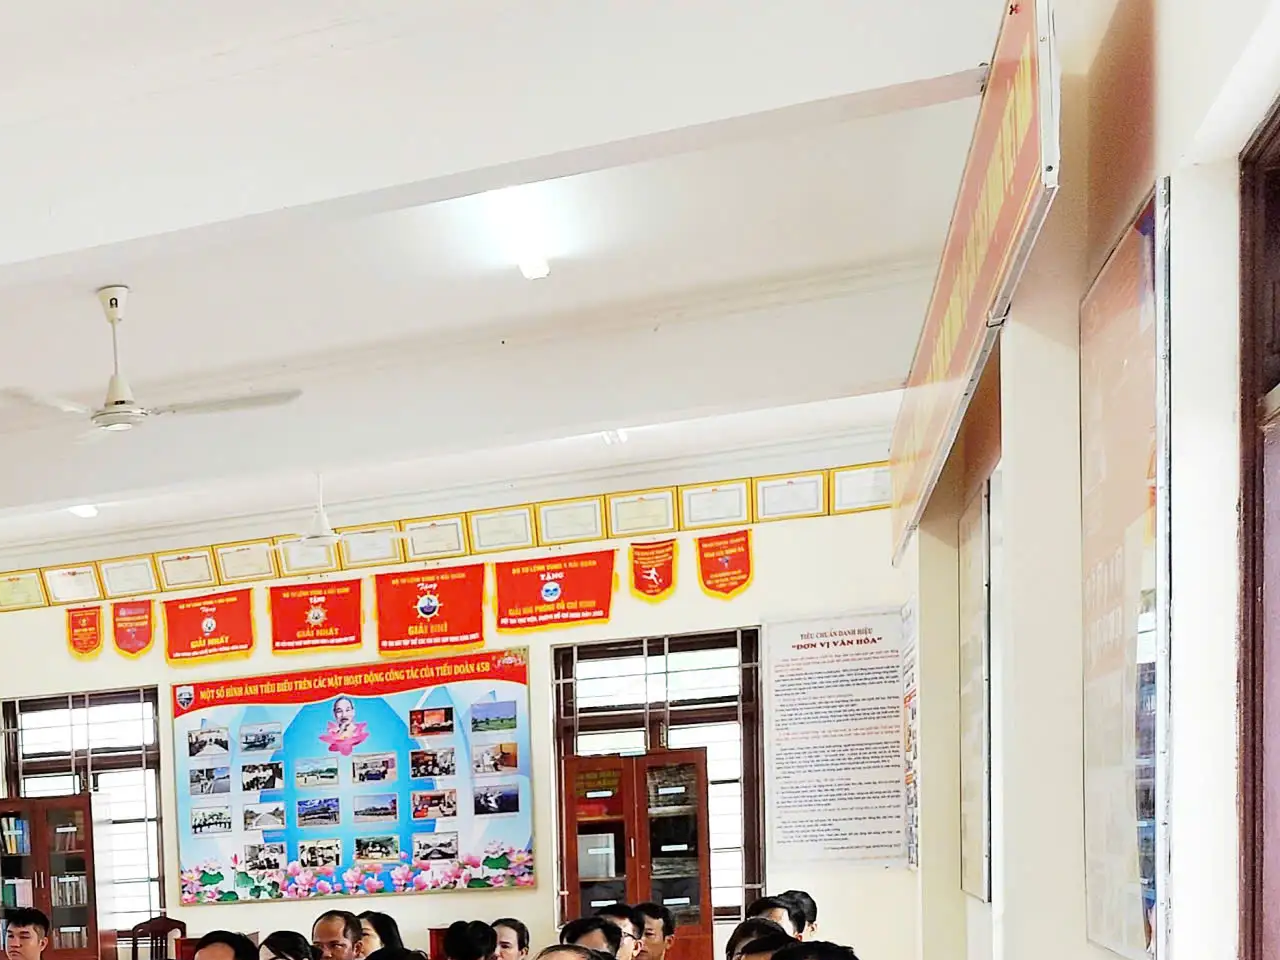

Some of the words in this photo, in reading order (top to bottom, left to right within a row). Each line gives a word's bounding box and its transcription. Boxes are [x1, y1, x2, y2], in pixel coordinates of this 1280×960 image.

[199, 688, 215, 701] MỘT
[216, 686, 225, 699] SỐ
[294, 677, 312, 690] TRÊN
[313, 675, 326, 689] CÁC
[327, 674, 342, 688] MẶT
[343, 674, 363, 687] HOẠT
[363, 671, 384, 685] ĐỘNG
[385, 668, 405, 682] CÔNG
[405, 666, 420, 679] TÁC
[420, 664, 434, 678] CỦA
[435, 662, 453, 676] TIỂU
[454, 660, 475, 675] ĐOÀN
